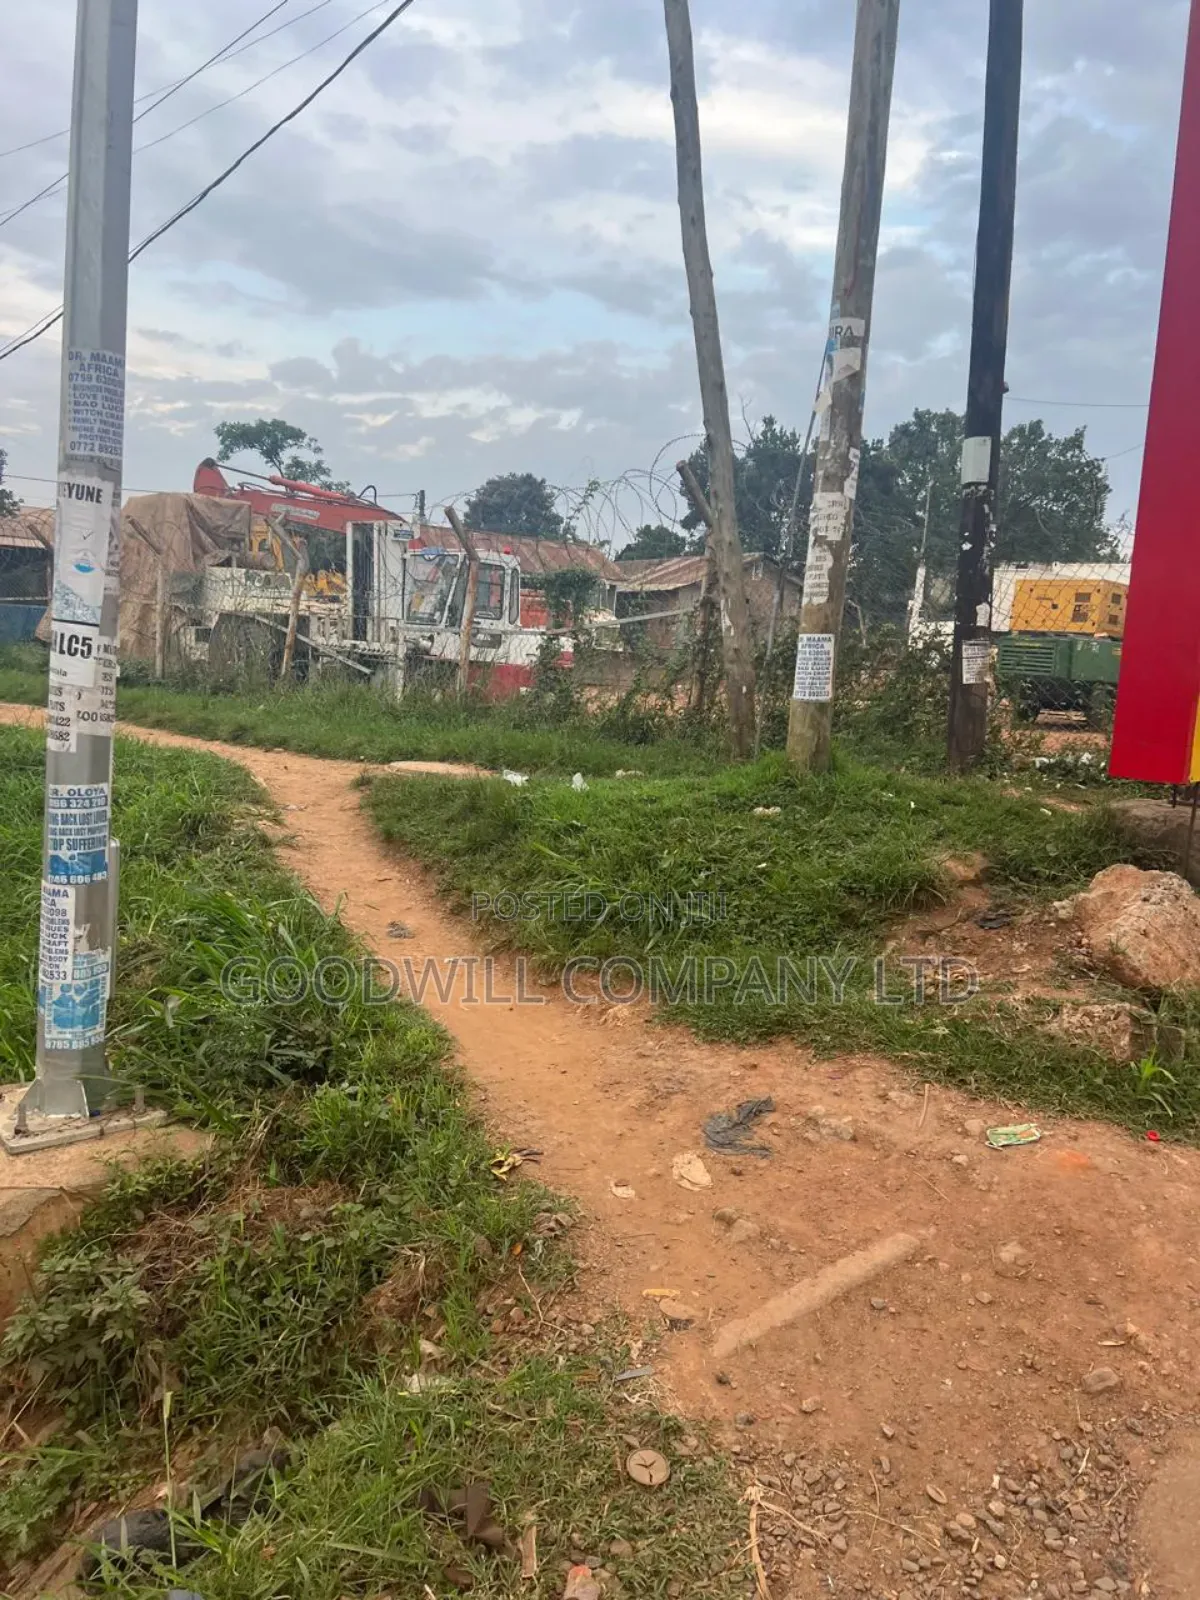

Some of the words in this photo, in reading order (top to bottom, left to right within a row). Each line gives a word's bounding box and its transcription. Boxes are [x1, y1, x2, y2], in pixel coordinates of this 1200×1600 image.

[68, 350, 86, 362] DR.
[79, 363, 120, 378] AFRICA
[73, 392, 99, 401] LOVE
[73, 409, 103, 418] WITCH
[69, 440, 95, 451] 0772
[67, 787, 107, 797] OLOYA
